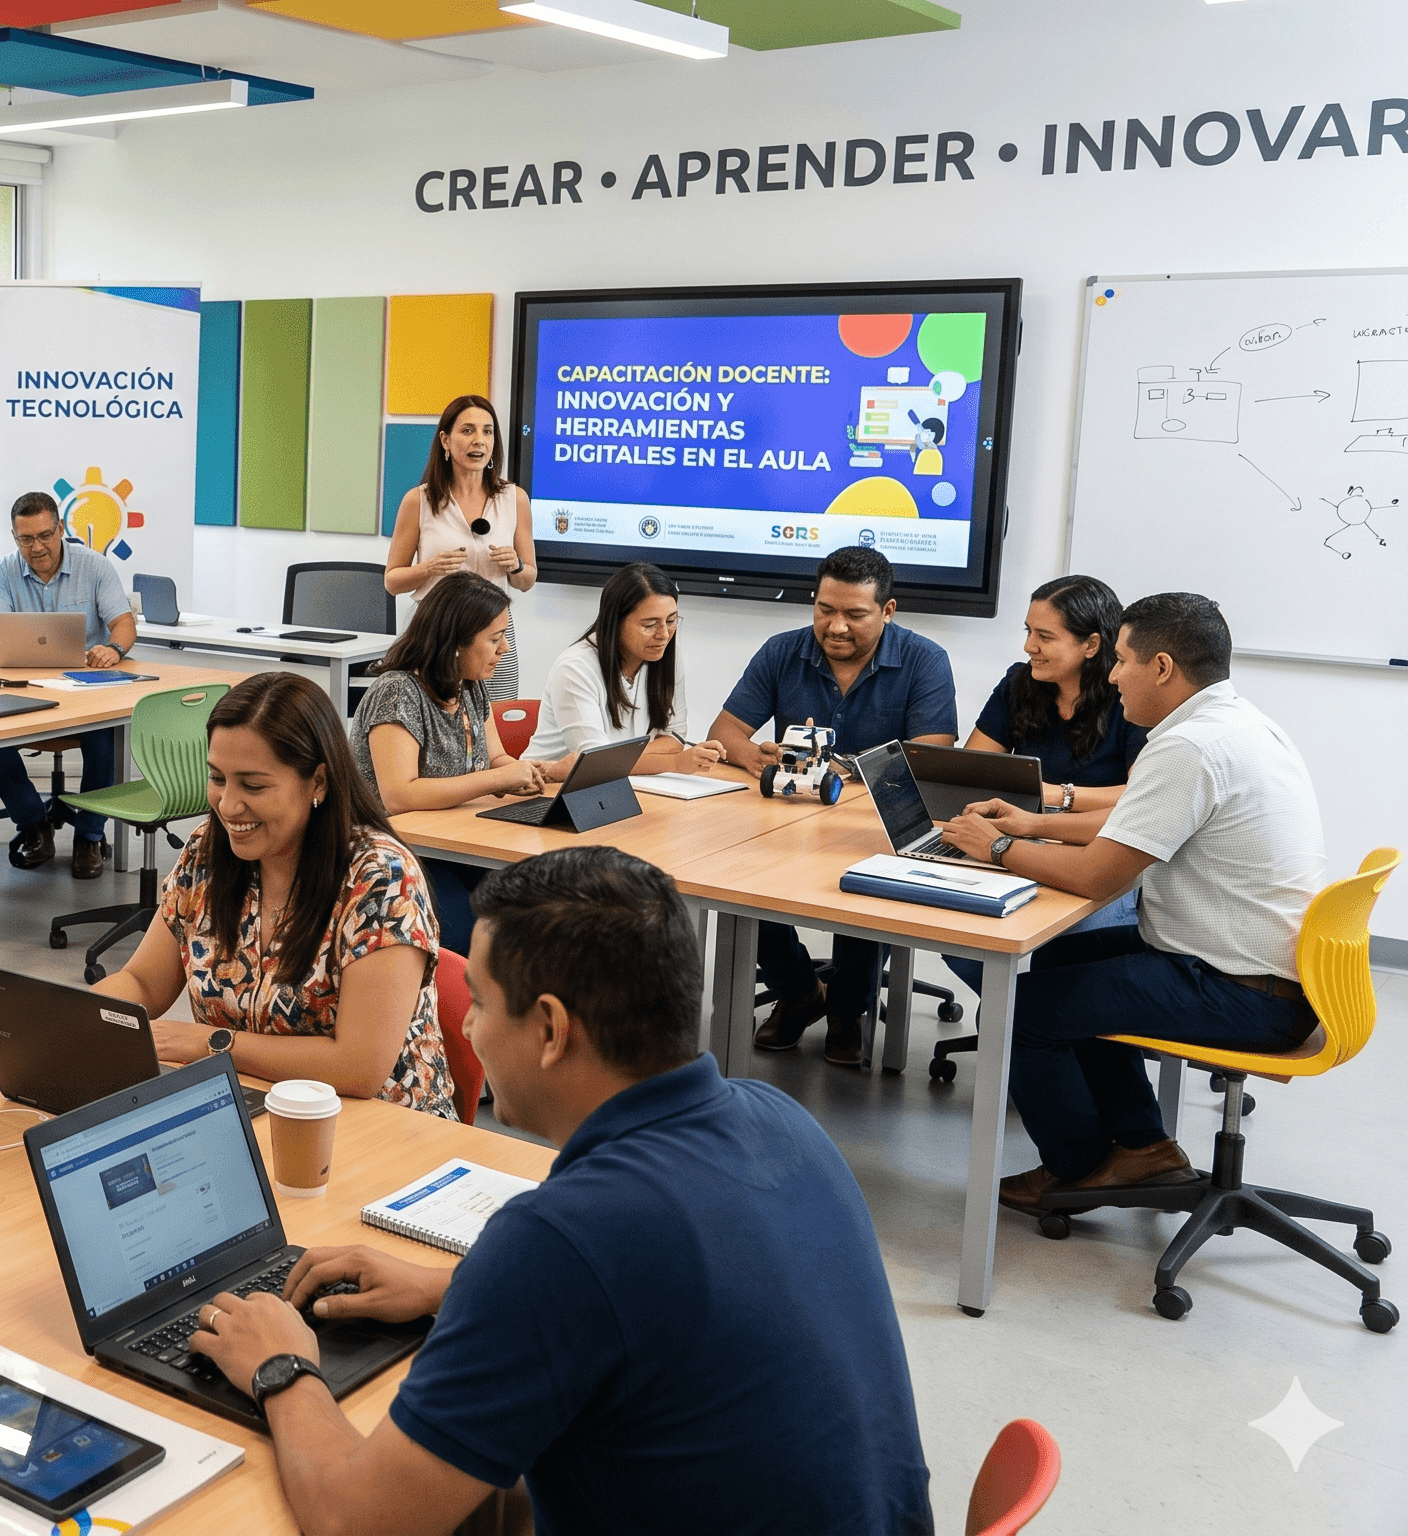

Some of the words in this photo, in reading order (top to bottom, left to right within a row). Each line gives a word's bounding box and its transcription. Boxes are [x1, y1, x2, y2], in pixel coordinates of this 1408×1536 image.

[415, 161, 582, 213] CREAR
[631, 131, 974, 200] APRENDER
[1042, 99, 1408, 175] INNOVAR
[17, 366, 173, 390] INNOVACIÓN
[557, 361, 712, 382] CAPACITACIÓN
[719, 365, 831, 384] DOCENTE:
[5, 394, 184, 419] TECNOLÓGICA
[557, 387, 710, 411] INNOVACIÓN
[717, 392, 735, 411] Y
[555, 417, 745, 440] HERRAMIENTAS
[554, 443, 676, 466] DIGITALES
[683, 447, 716, 467] EN
[724, 448, 753, 468] EL
[759, 449, 832, 471] AULA
